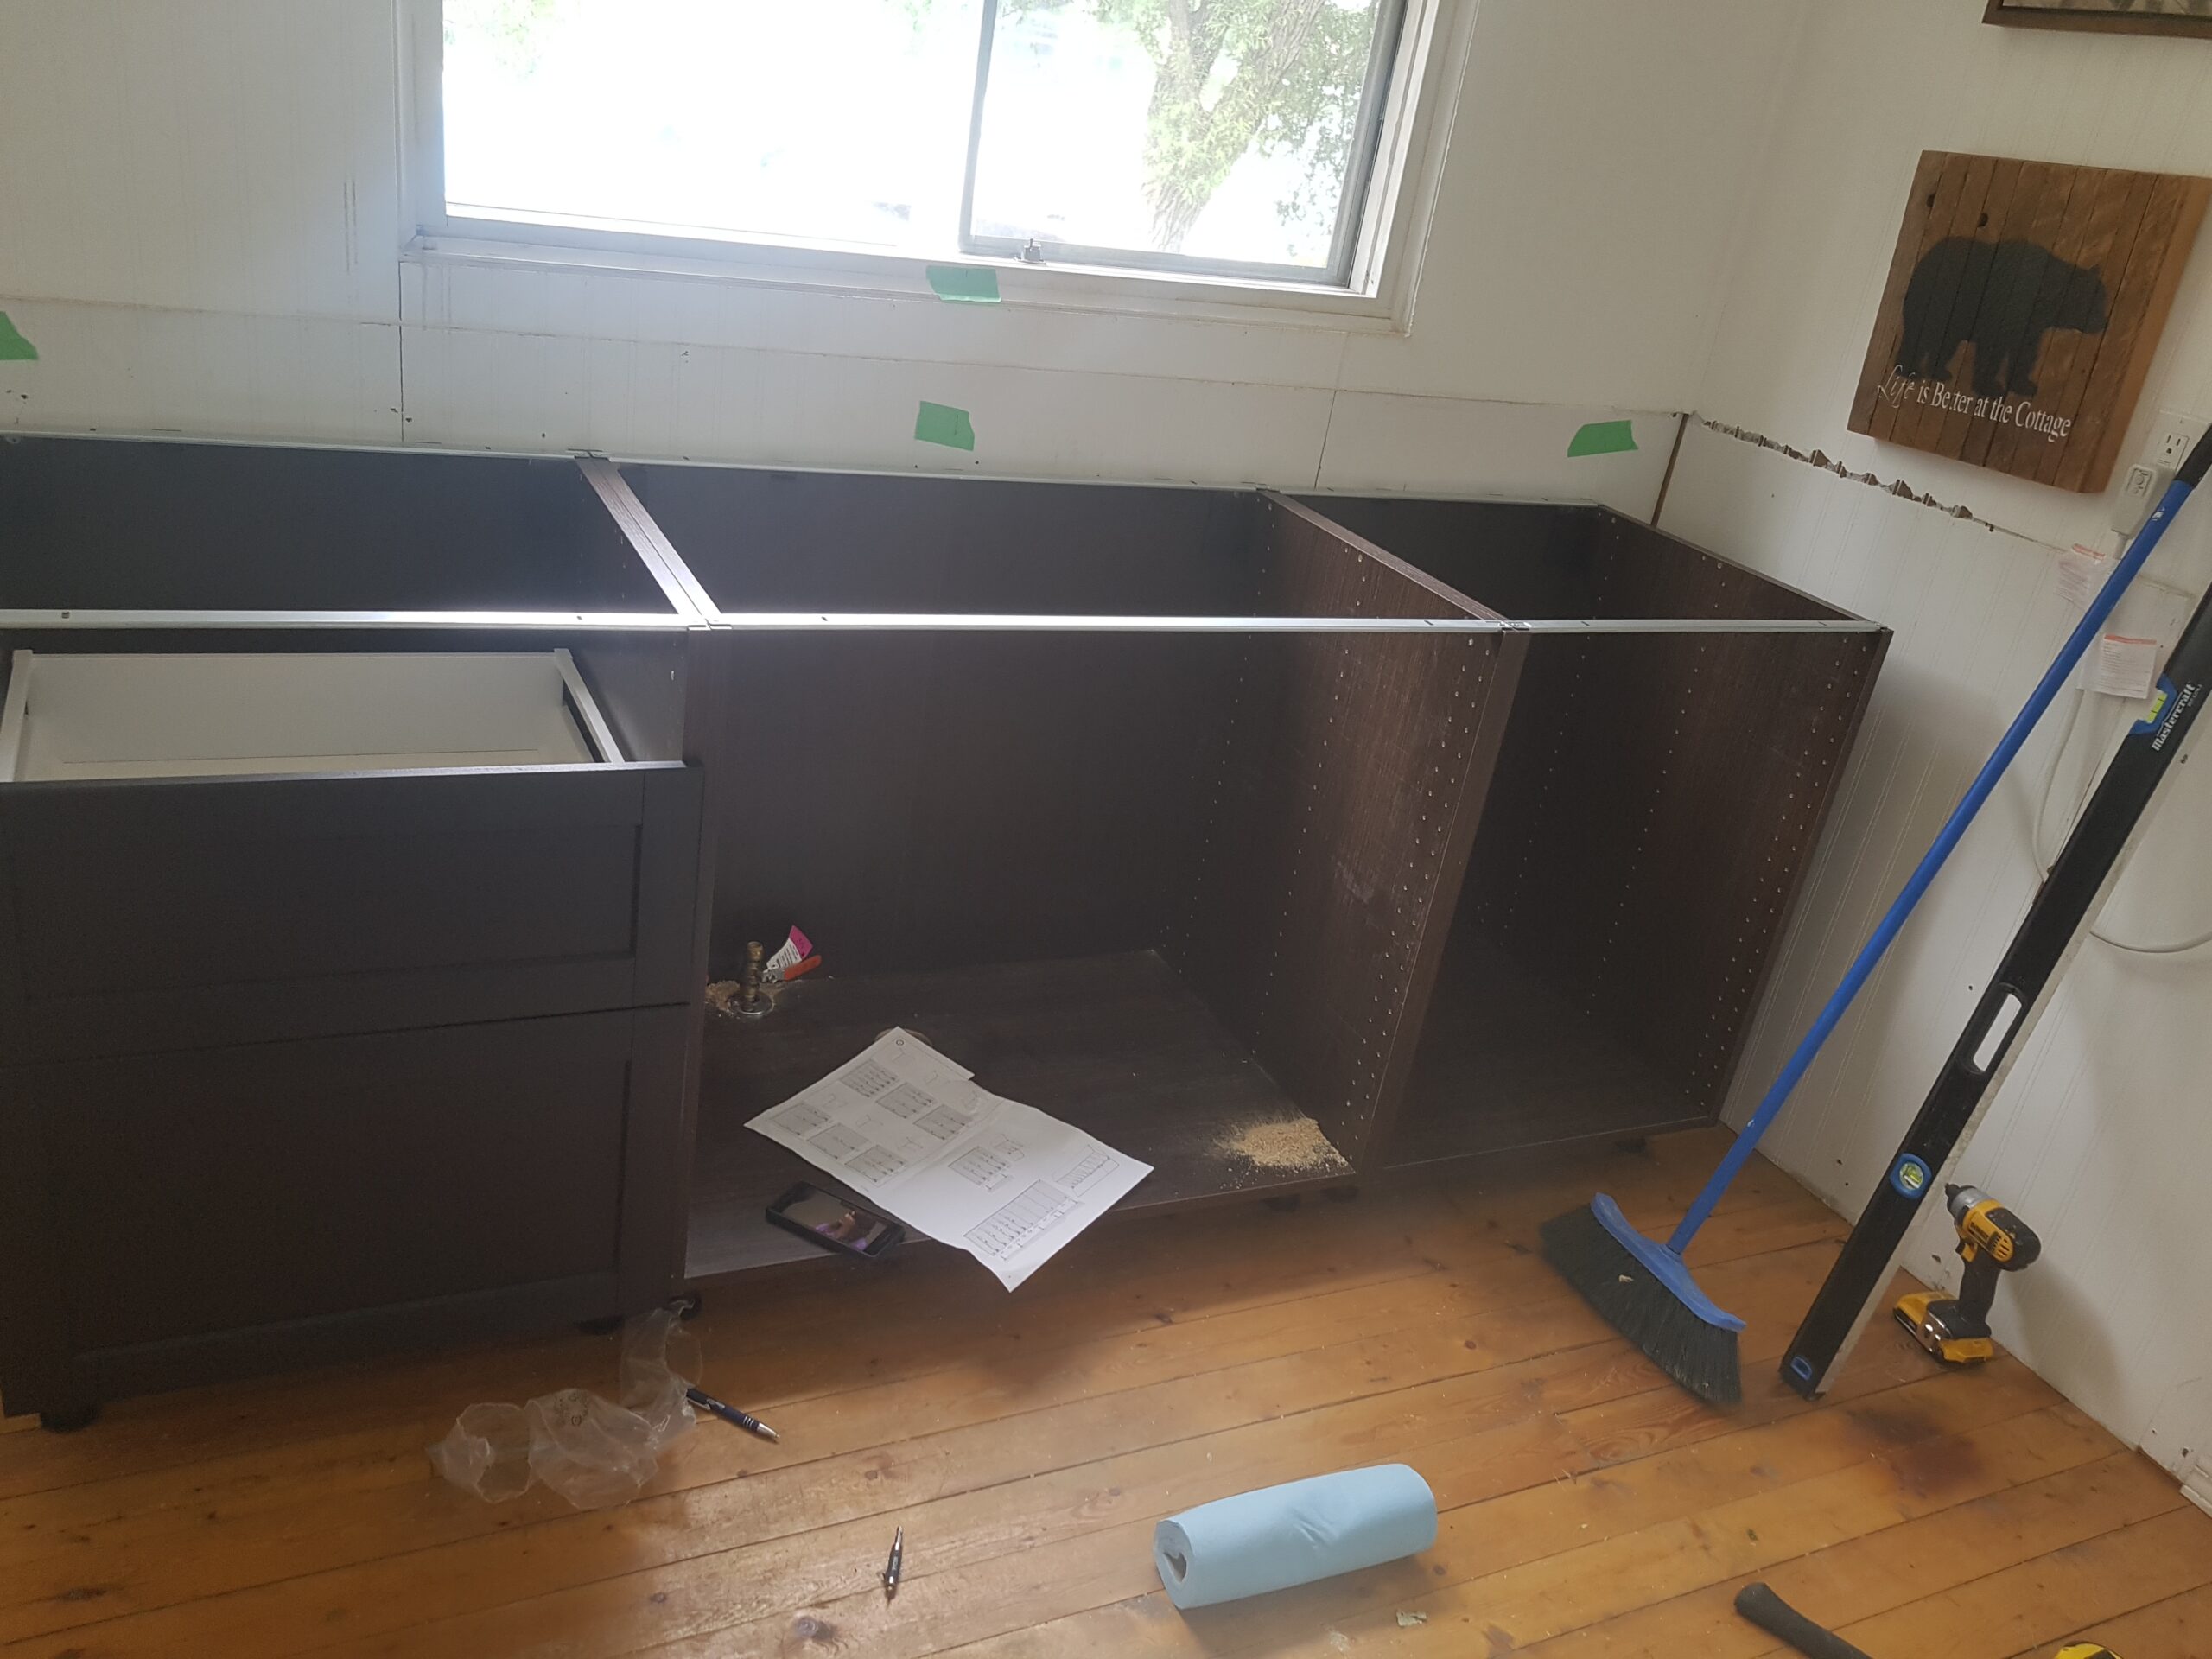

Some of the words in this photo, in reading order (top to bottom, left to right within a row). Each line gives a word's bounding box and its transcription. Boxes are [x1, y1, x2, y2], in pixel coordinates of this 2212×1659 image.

[1878, 365, 1916, 408] Life
[1916, 379, 1930, 404] is
[1930, 381, 1974, 415] Beter
[1974, 397, 1988, 418] at
[1989, 396, 2012, 423] the
[2015, 401, 2071, 442] Cottage
[2152, 683, 2196, 751] Mastercraft
